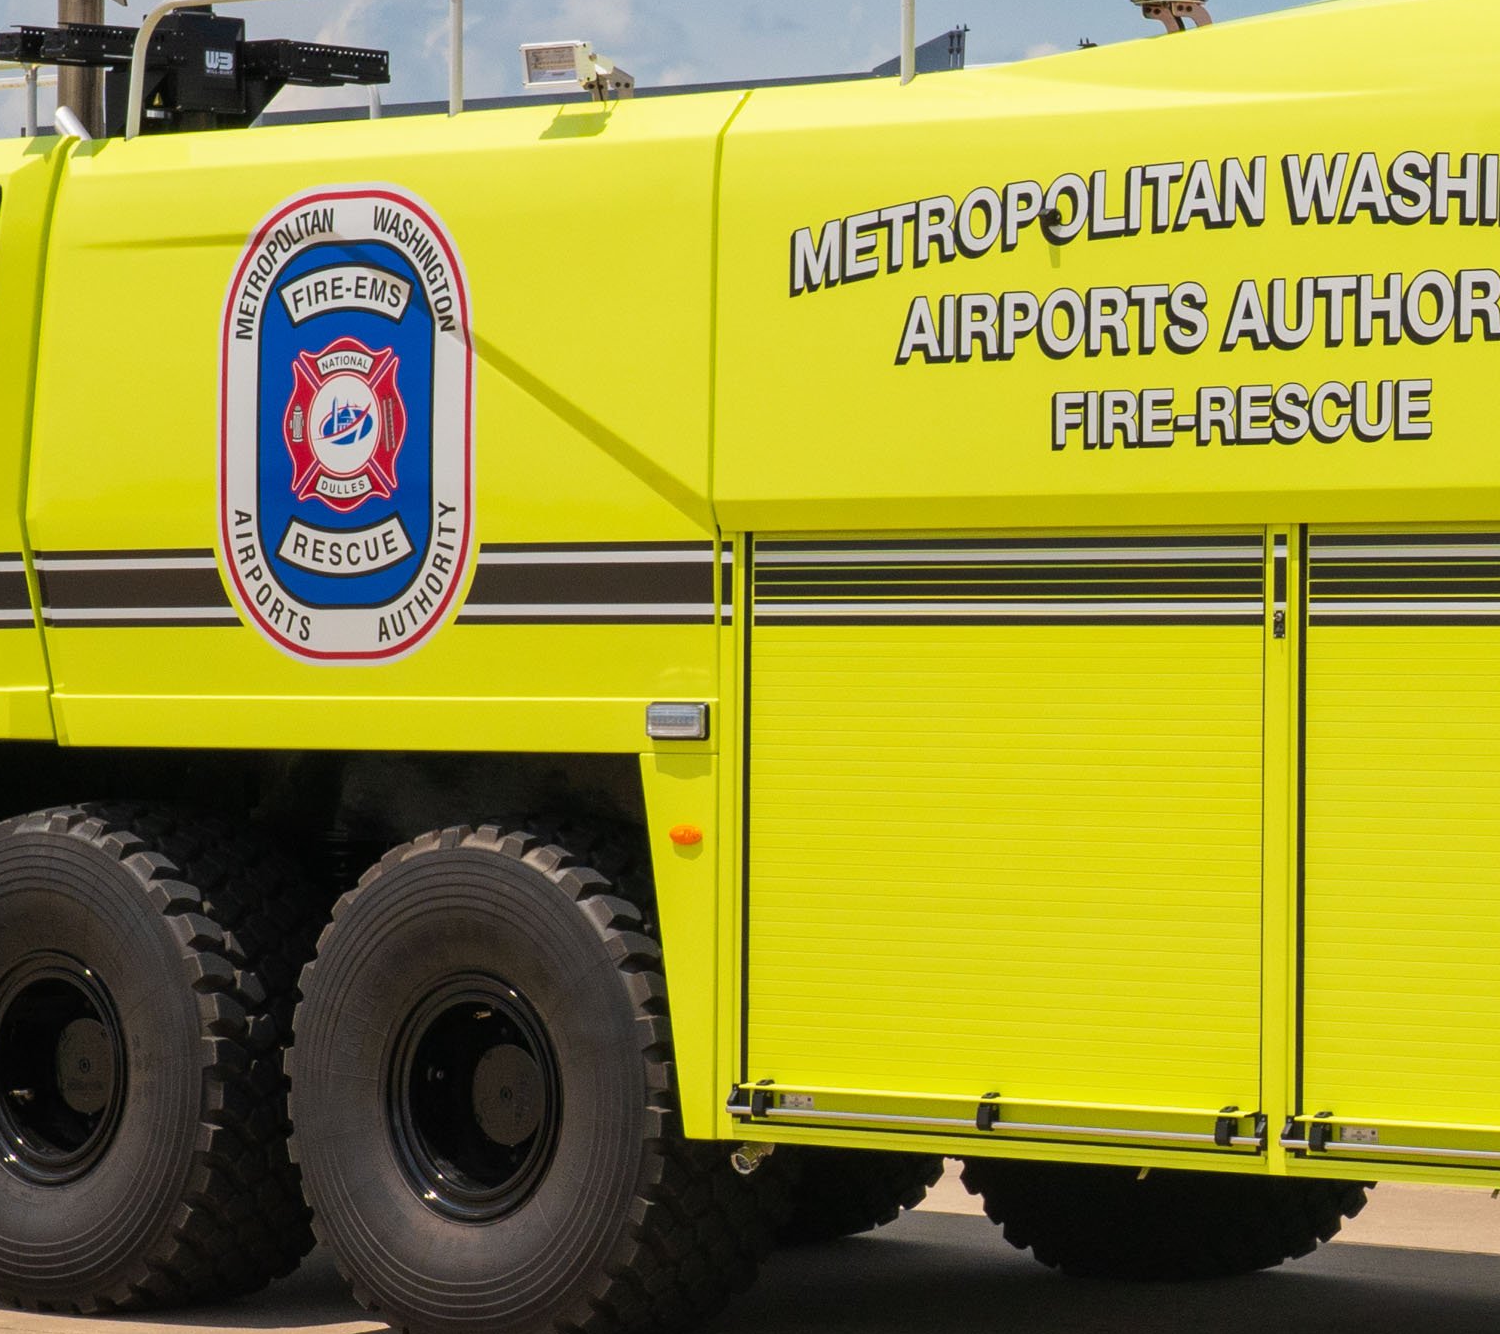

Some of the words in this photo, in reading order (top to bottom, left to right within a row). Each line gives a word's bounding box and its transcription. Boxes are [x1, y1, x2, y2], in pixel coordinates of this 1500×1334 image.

[789, 154, 1267, 297] METROPOLITAN
[234, 207, 334, 341] METROPOLITAN
[373, 205, 457, 333] WASHINGTON
[290, 275, 403, 315] FIRE-EMS
[894, 282, 1208, 366] AIRPORTS
[320, 354, 370, 374] NATIONAL
[1051, 378, 1434, 451] FIRE-RESCUE
[320, 478, 366, 496] DULLES
[234, 509, 312, 643] AIRPORTS
[377, 501, 458, 644] AUTHORITY
[292, 529, 400, 566] RESCUE
